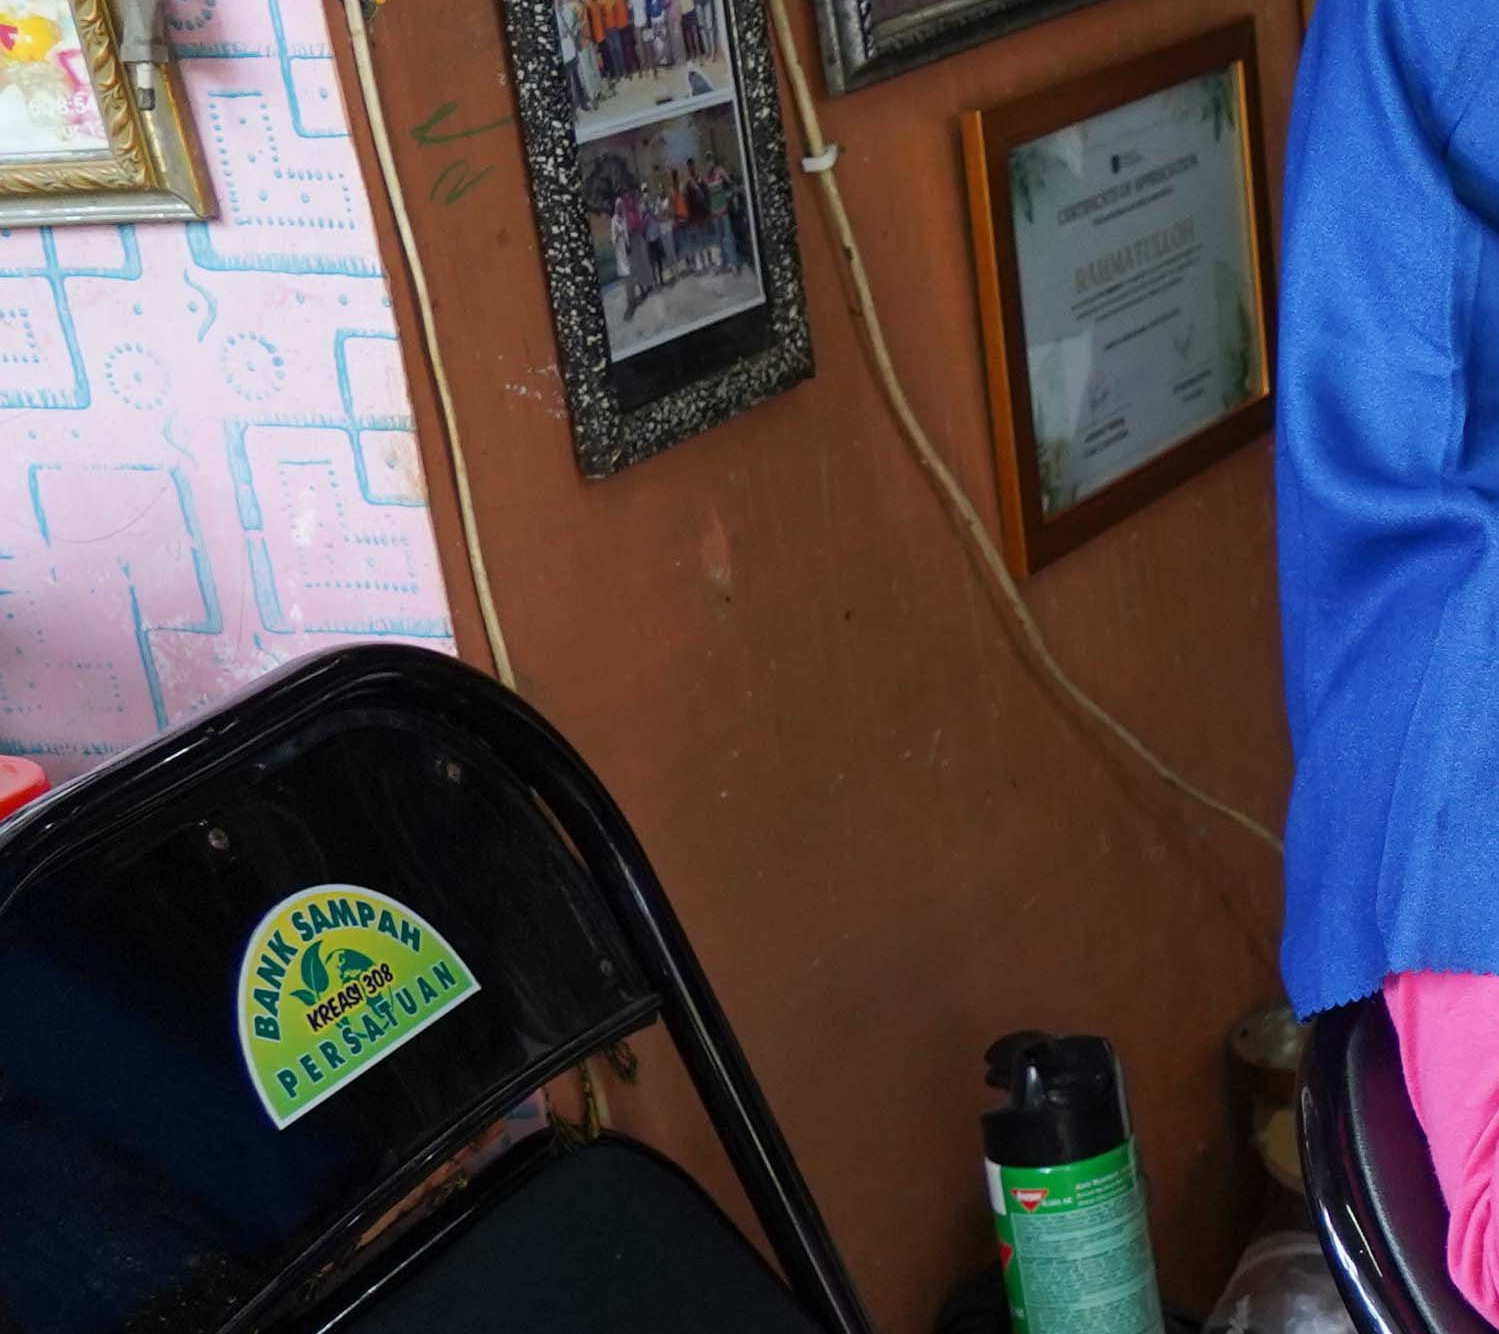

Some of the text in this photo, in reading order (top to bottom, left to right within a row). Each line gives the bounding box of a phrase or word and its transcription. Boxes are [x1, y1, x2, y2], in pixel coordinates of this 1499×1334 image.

[253, 898, 421, 1041] BANK SAMPAH
[276, 961, 457, 1099] PERSATUAN
[306, 963, 394, 1032] KREASI 308
